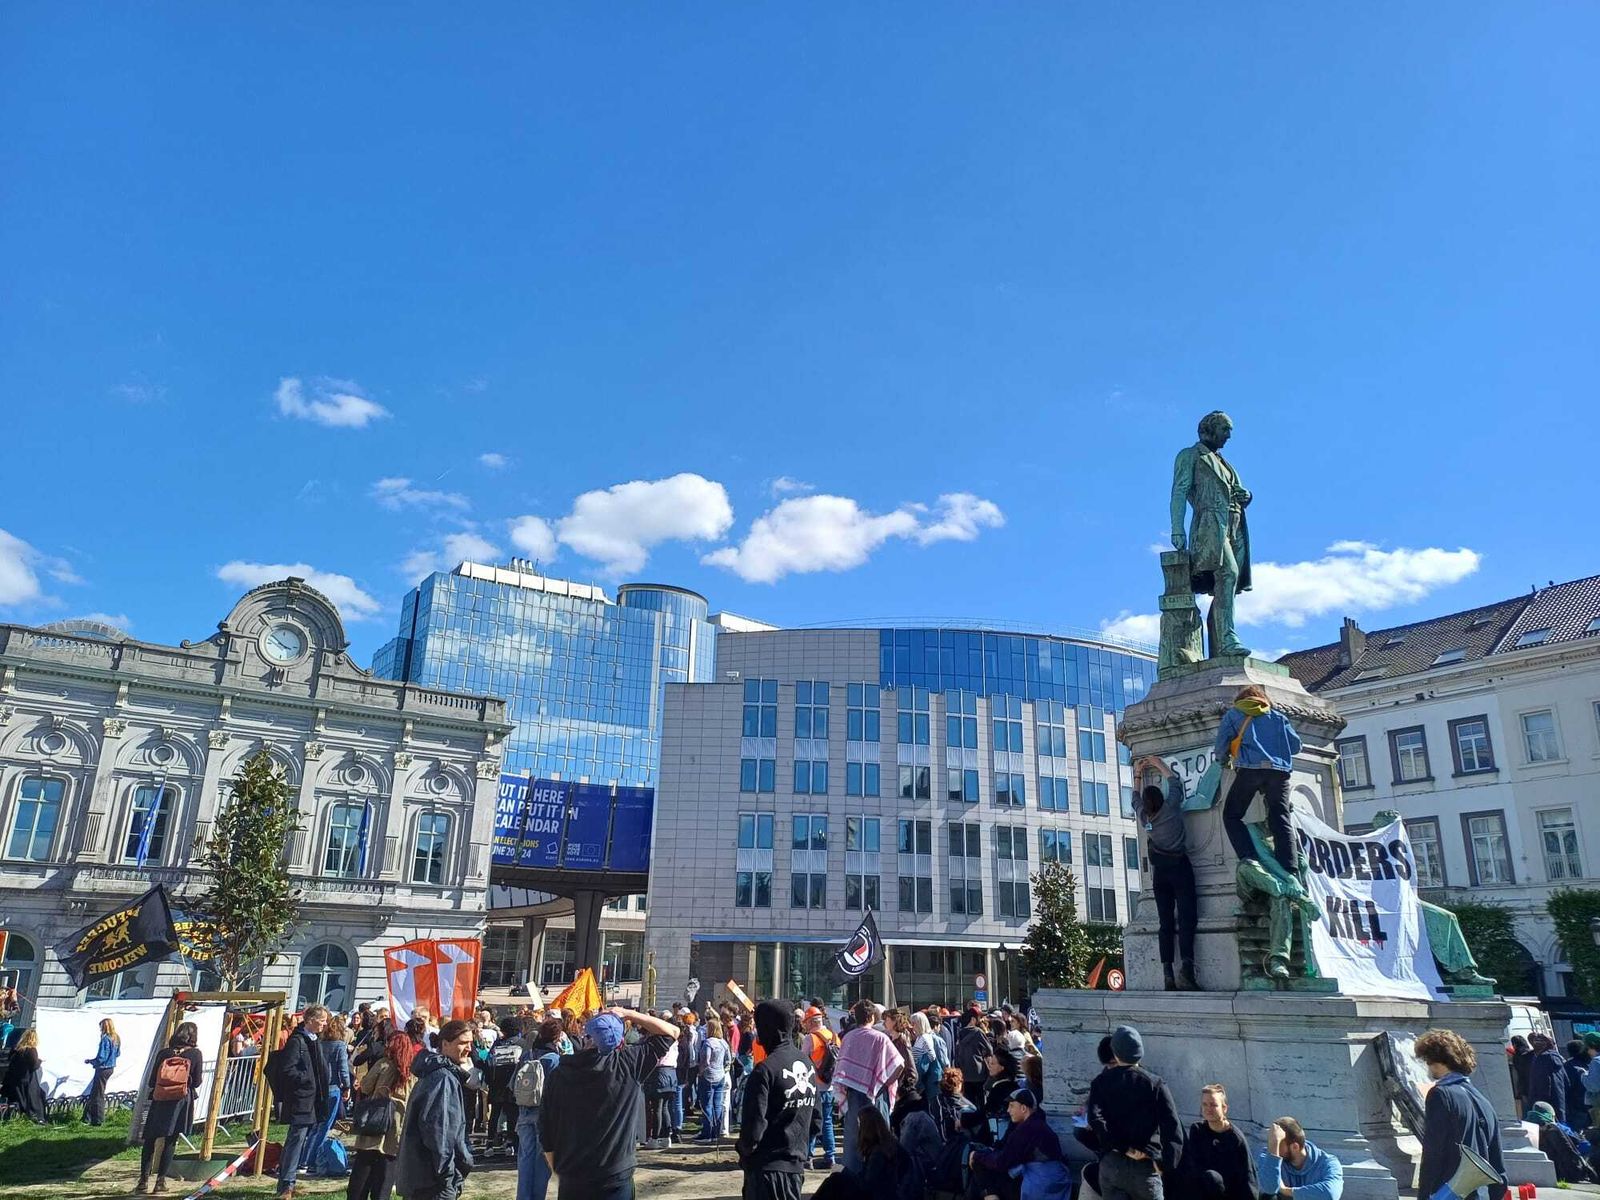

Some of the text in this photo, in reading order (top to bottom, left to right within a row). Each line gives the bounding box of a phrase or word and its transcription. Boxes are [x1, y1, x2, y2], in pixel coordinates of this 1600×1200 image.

[517, 785, 528, 800] IT
[533, 788, 565, 804] HERE
[497, 798, 515, 814] AN
[546, 805, 559, 818] IT
[495, 813, 560, 834] CALENDAR
[1326, 895, 1388, 941] KILL
